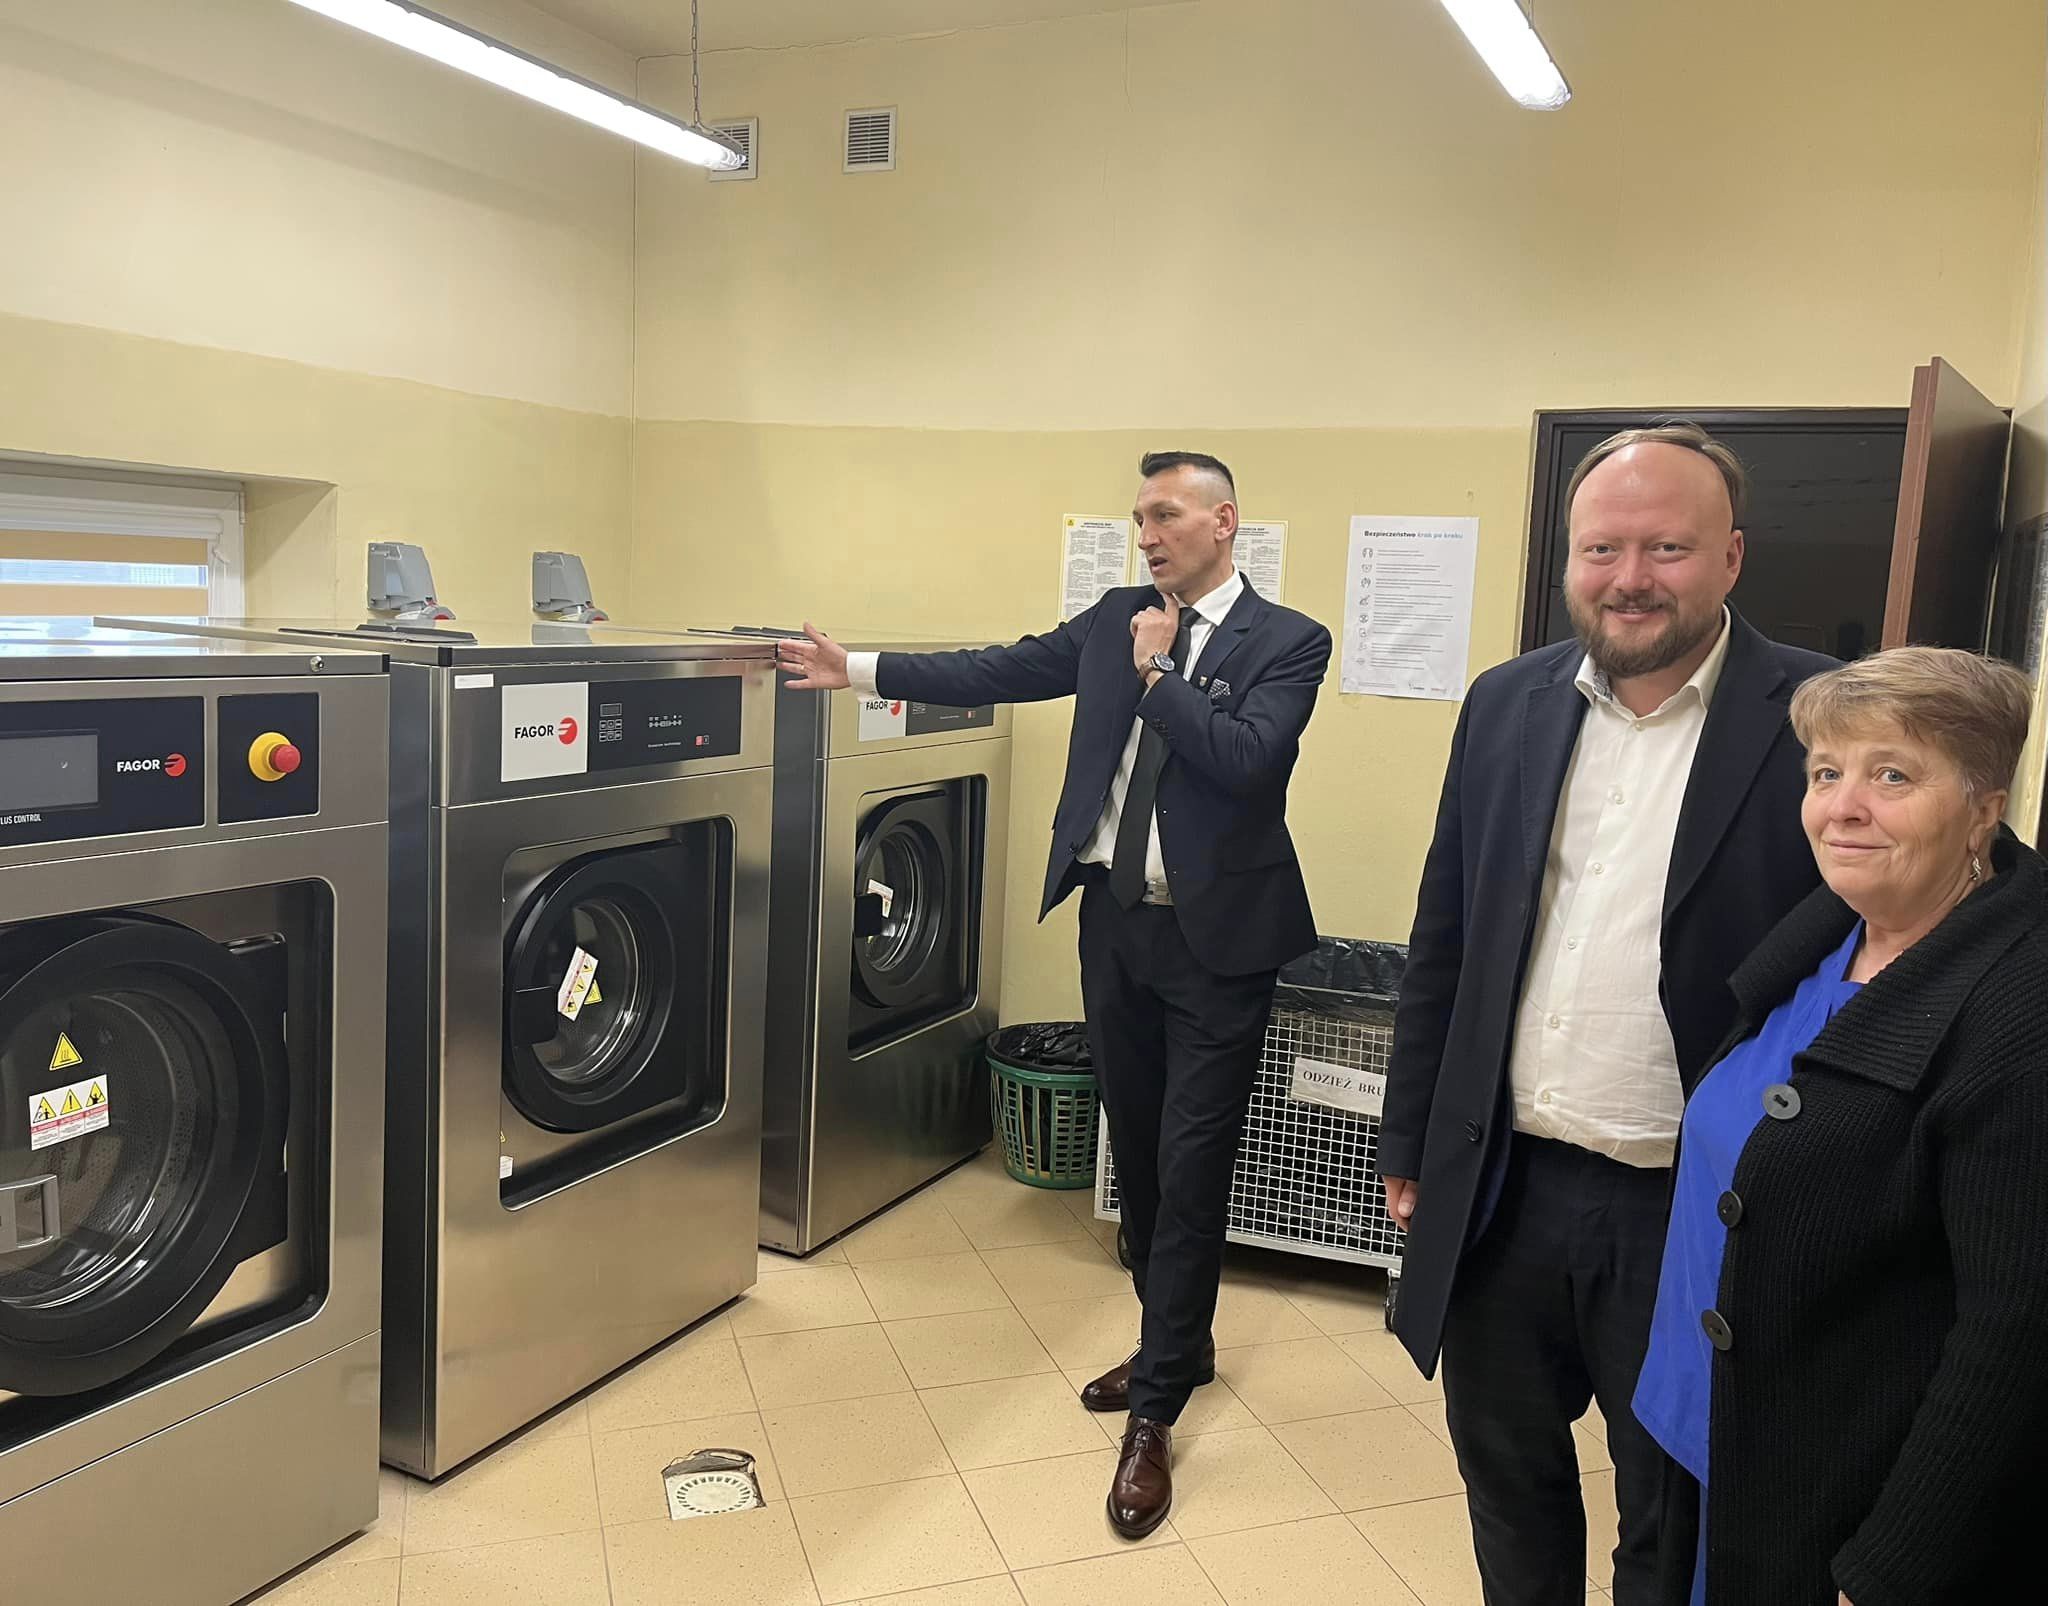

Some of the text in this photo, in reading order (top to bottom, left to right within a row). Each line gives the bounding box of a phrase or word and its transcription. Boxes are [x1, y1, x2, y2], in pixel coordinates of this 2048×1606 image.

[866, 701, 888, 710] FAGOR
[514, 725, 554, 739] FAGOR
[116, 759, 160, 773] FAGOR
[0, 813, 42, 825] LUS CONTROL
